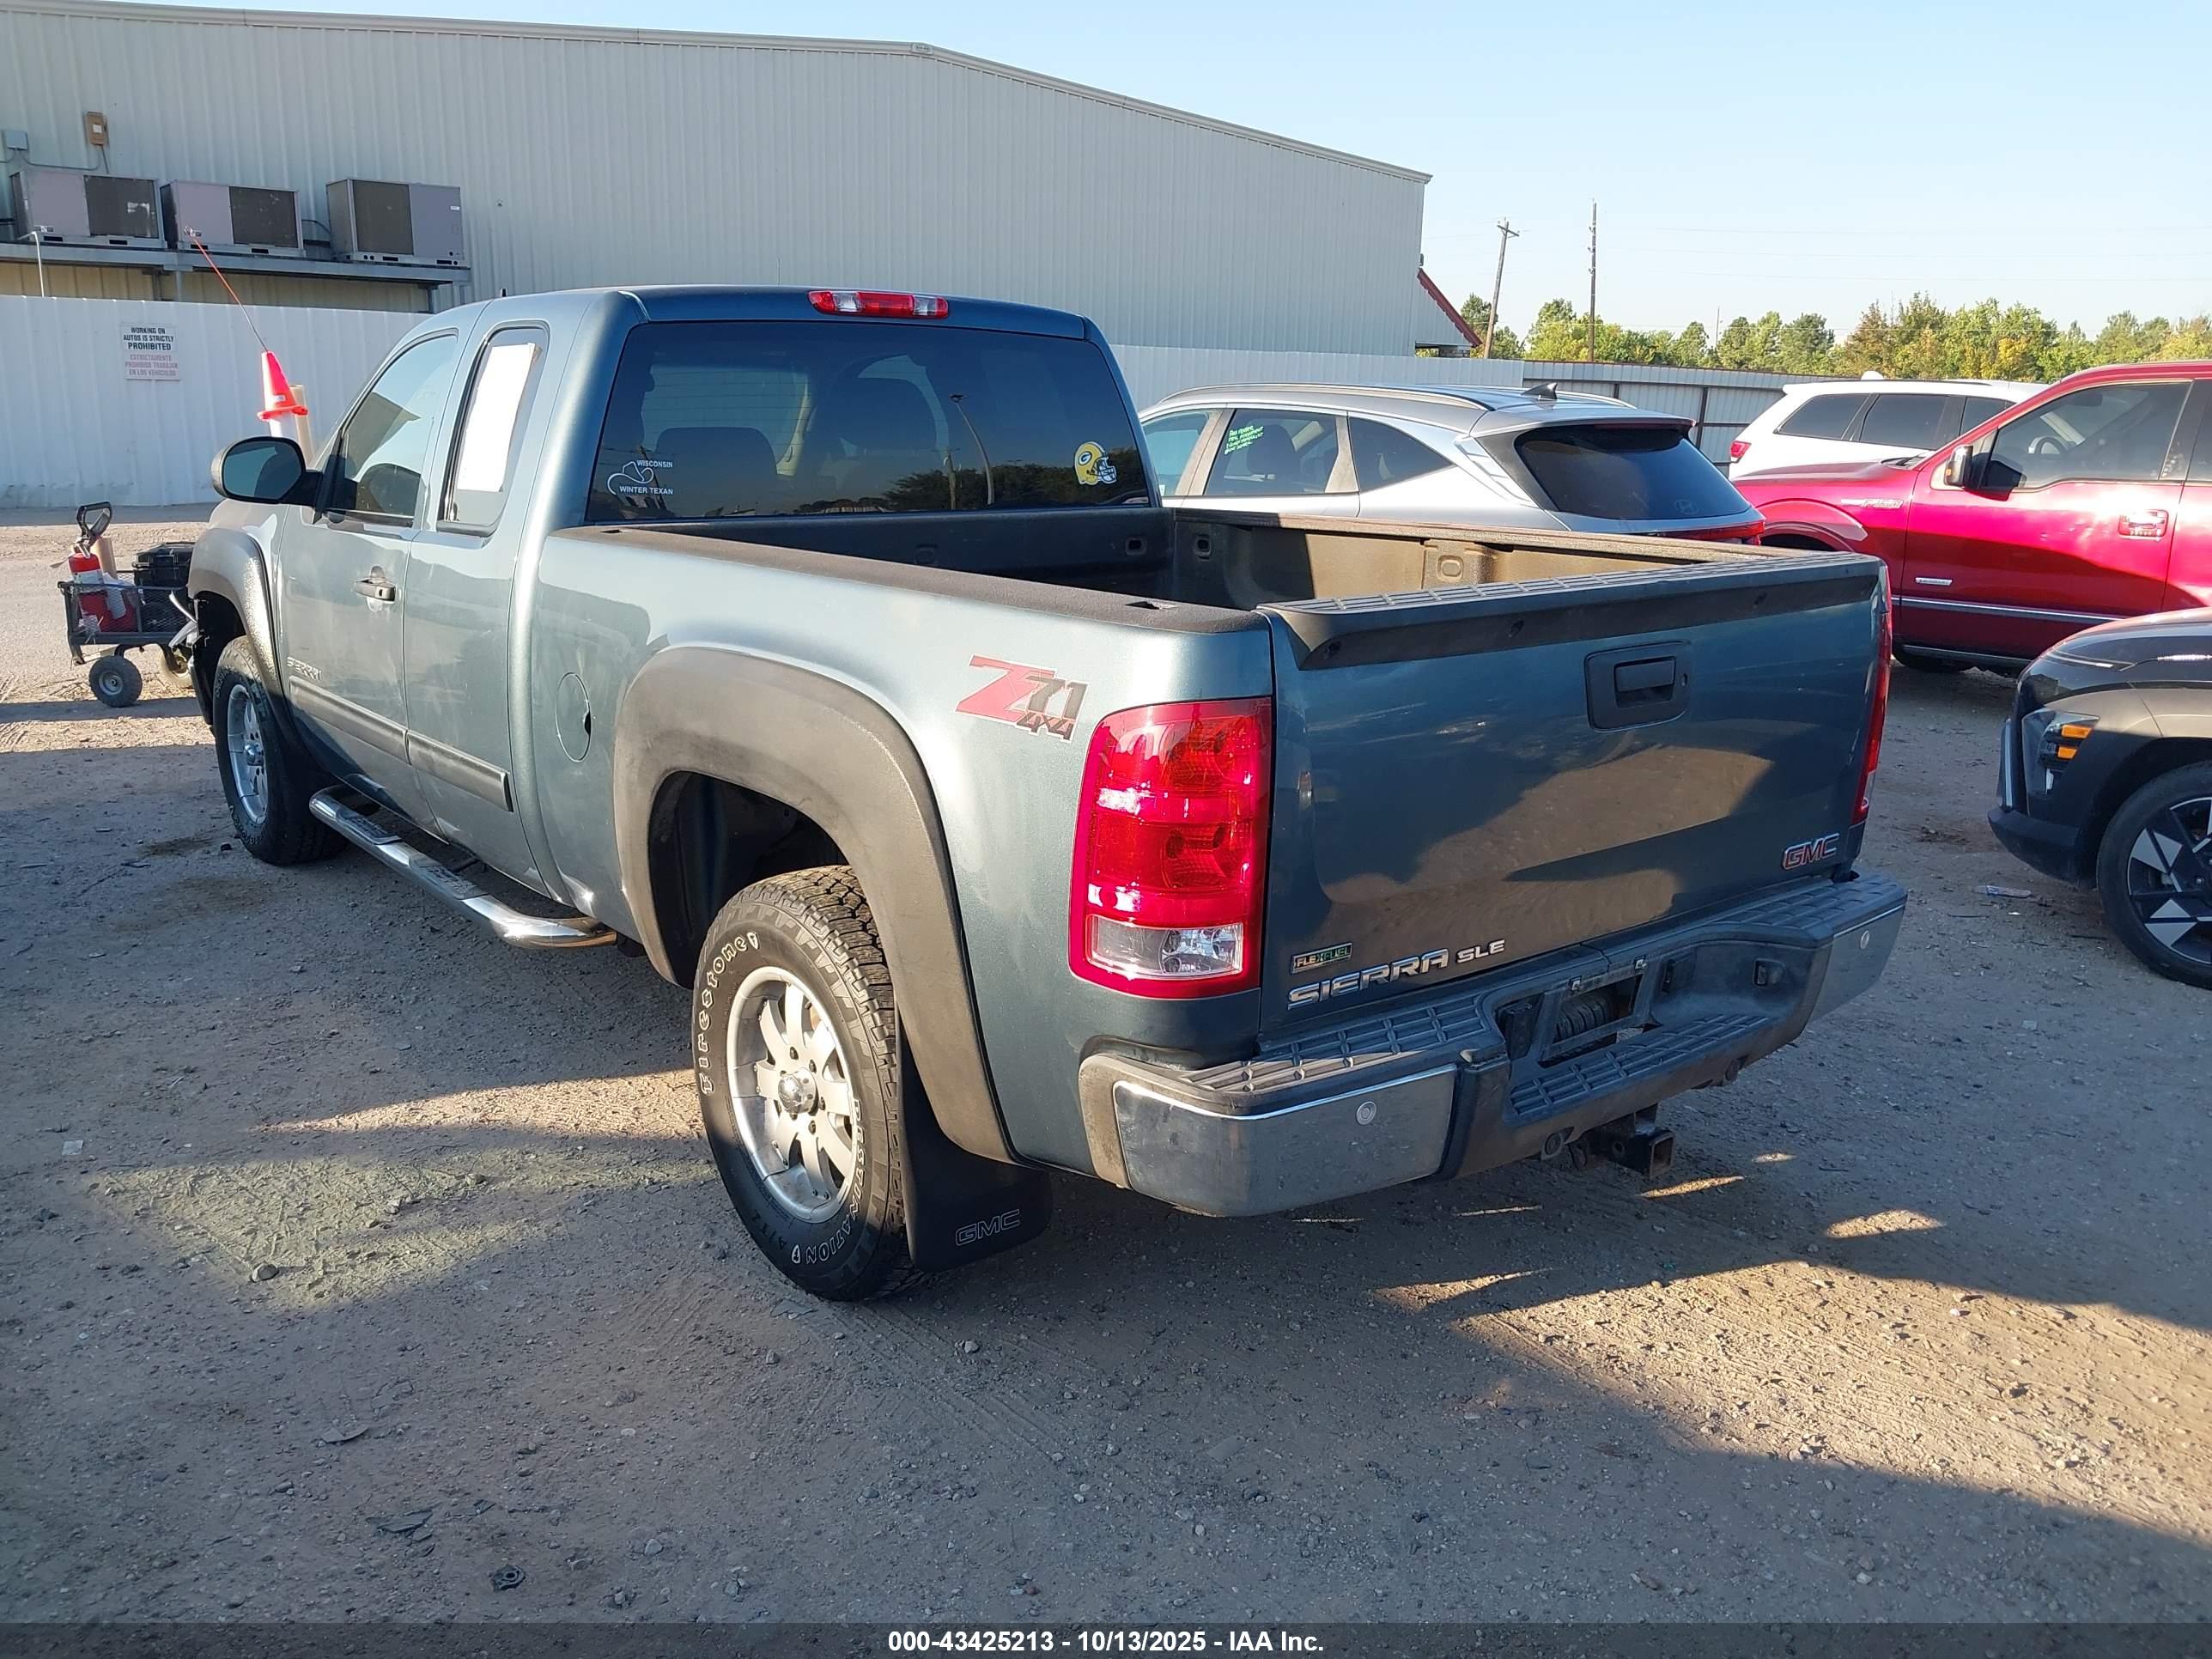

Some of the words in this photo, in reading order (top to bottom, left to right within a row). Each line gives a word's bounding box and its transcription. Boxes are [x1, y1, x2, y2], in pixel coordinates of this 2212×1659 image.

[128, 342, 172, 350] PROHIBITED
[636, 459, 673, 468] WISCONSIN
[619, 485, 648, 495] WINTER
[649, 487, 673, 495] TEXAN
[956, 654, 1089, 722] Z71
[1783, 832, 1839, 870] GMC
[1457, 939, 1505, 963] SLE
[1288, 948, 1449, 1011] SIERRA
[955, 1208, 1021, 1246] GMC
